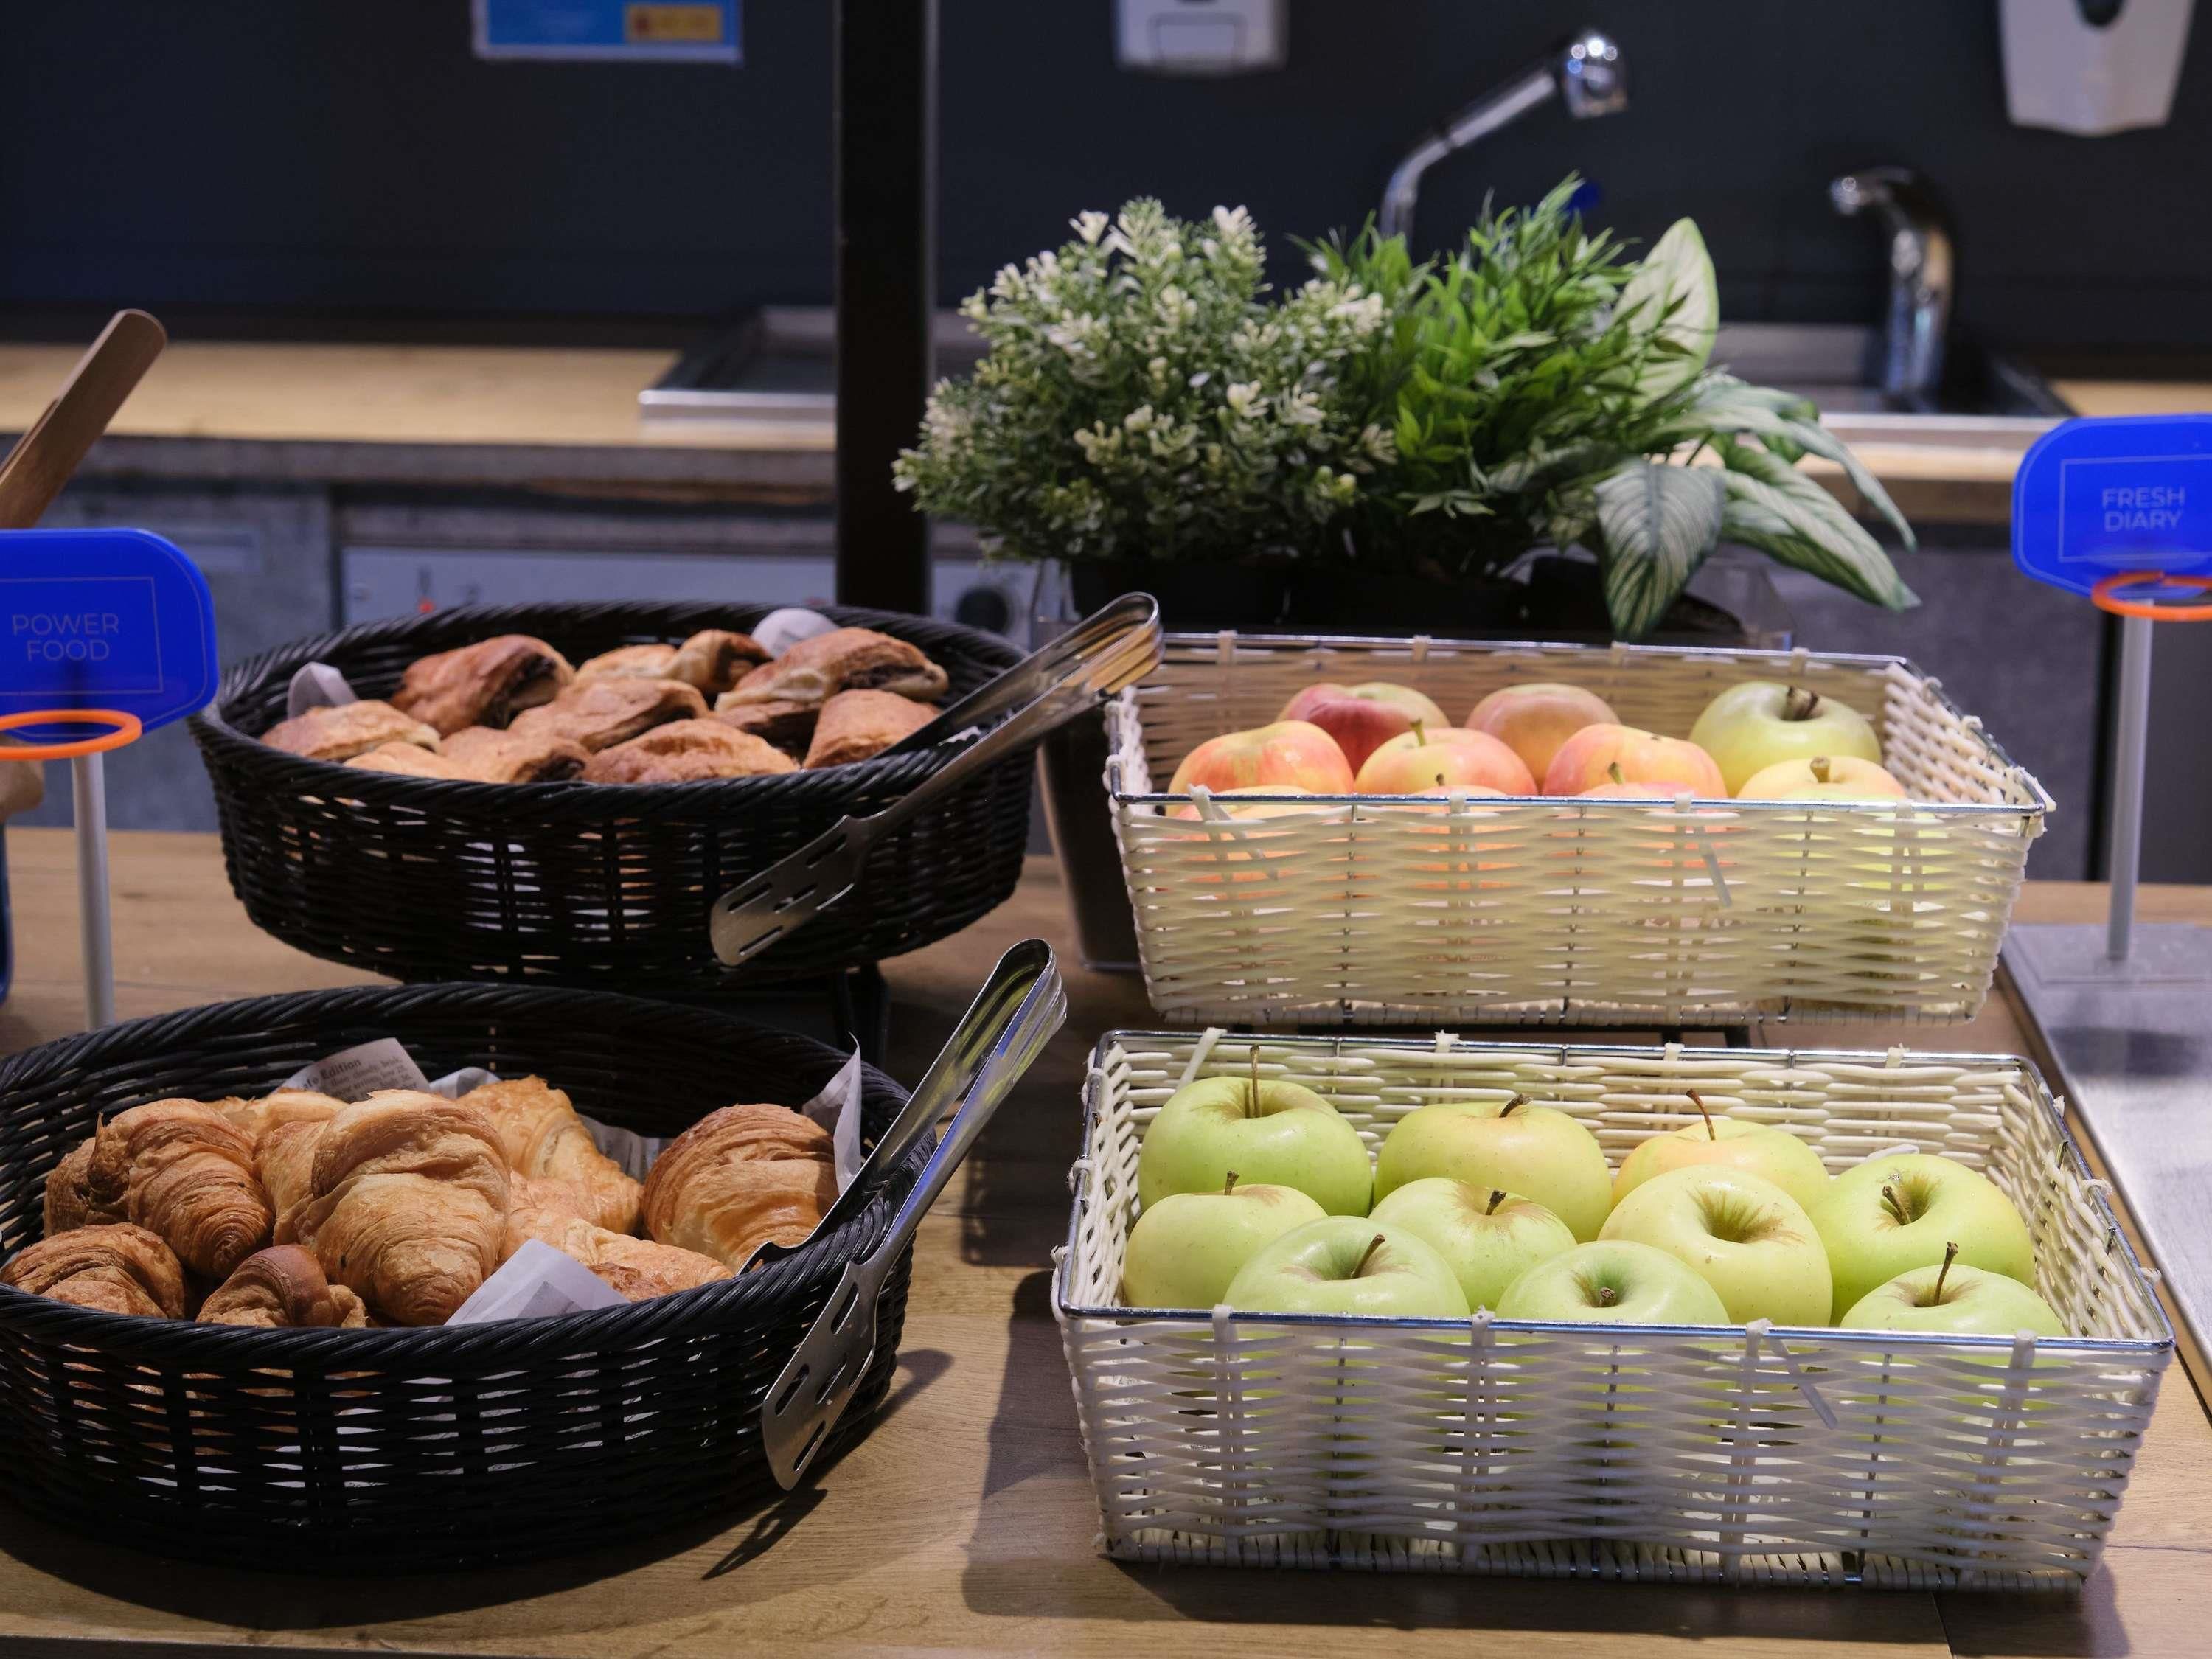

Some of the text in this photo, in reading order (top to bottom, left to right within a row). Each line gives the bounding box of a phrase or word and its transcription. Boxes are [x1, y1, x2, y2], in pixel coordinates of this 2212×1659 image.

[2102, 487, 2185, 508] FRESH
[2104, 509, 2183, 532] DIARY
[12, 613, 119, 636] POWER
[27, 640, 110, 661] FOOD
[319, 1060, 361, 1079] Edition
